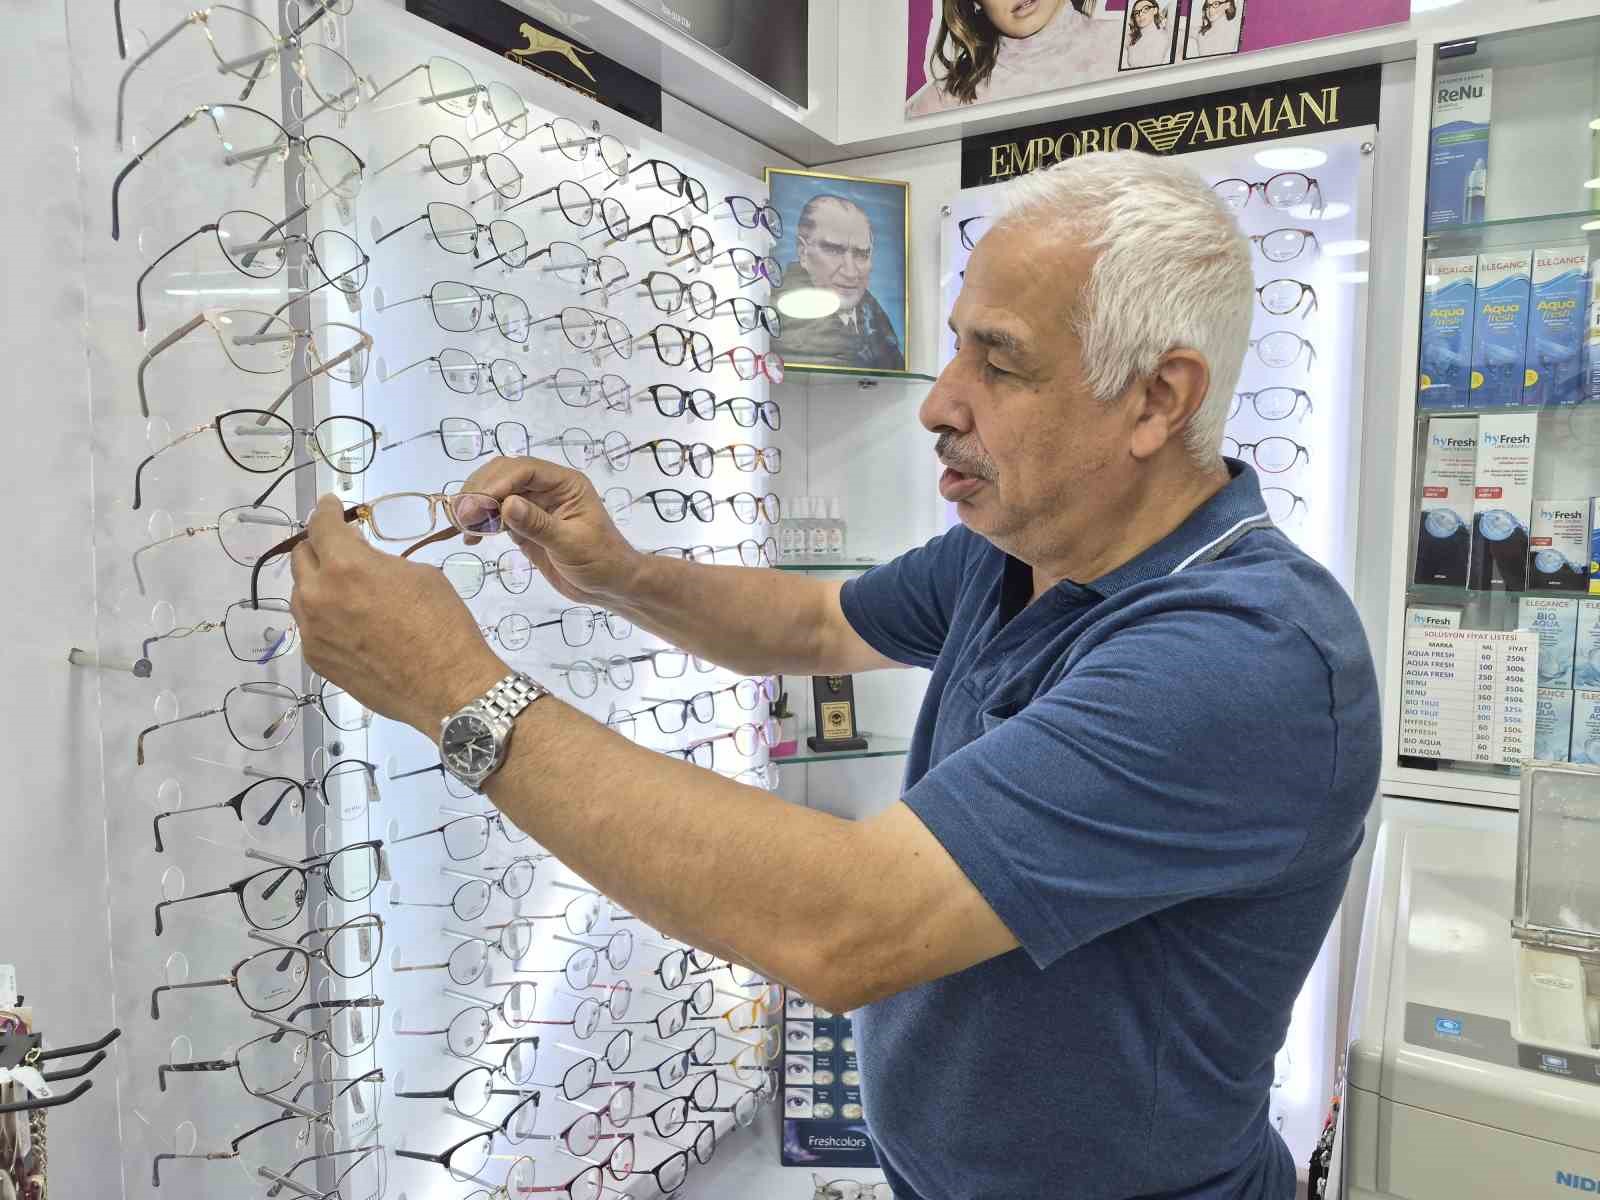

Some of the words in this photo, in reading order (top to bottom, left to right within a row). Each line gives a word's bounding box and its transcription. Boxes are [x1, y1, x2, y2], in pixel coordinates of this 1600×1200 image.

[1438, 84, 1483, 104] ReNu
[989, 121, 1139, 177] EMPORIO
[1188, 86, 1341, 146] ARMANI
[1537, 255, 1585, 267] ELEGANCE
[1482, 303, 1520, 314] Aqua
[1536, 299, 1576, 310] Aqua
[1430, 307, 1465, 318] Aqua
[1432, 433, 1477, 448] hyFresh
[1484, 431, 1530, 446] hyFresh
[1540, 509, 1583, 520] hyFresh
[1413, 613, 1451, 625] hyFresh
[1537, 612, 1557, 620] BIO
[1532, 620, 1560, 628] AQUA
[1407, 650, 1430, 658] AQUA
[1431, 661, 1455, 669] FRESH
[1430, 671, 1454, 679] FRESH
[1418, 739, 1441, 747] AQUA
[1418, 748, 1441, 756] AQUA
[808, 1135, 867, 1148] Freshcolors
[1555, 1170, 1600, 1195] NID
